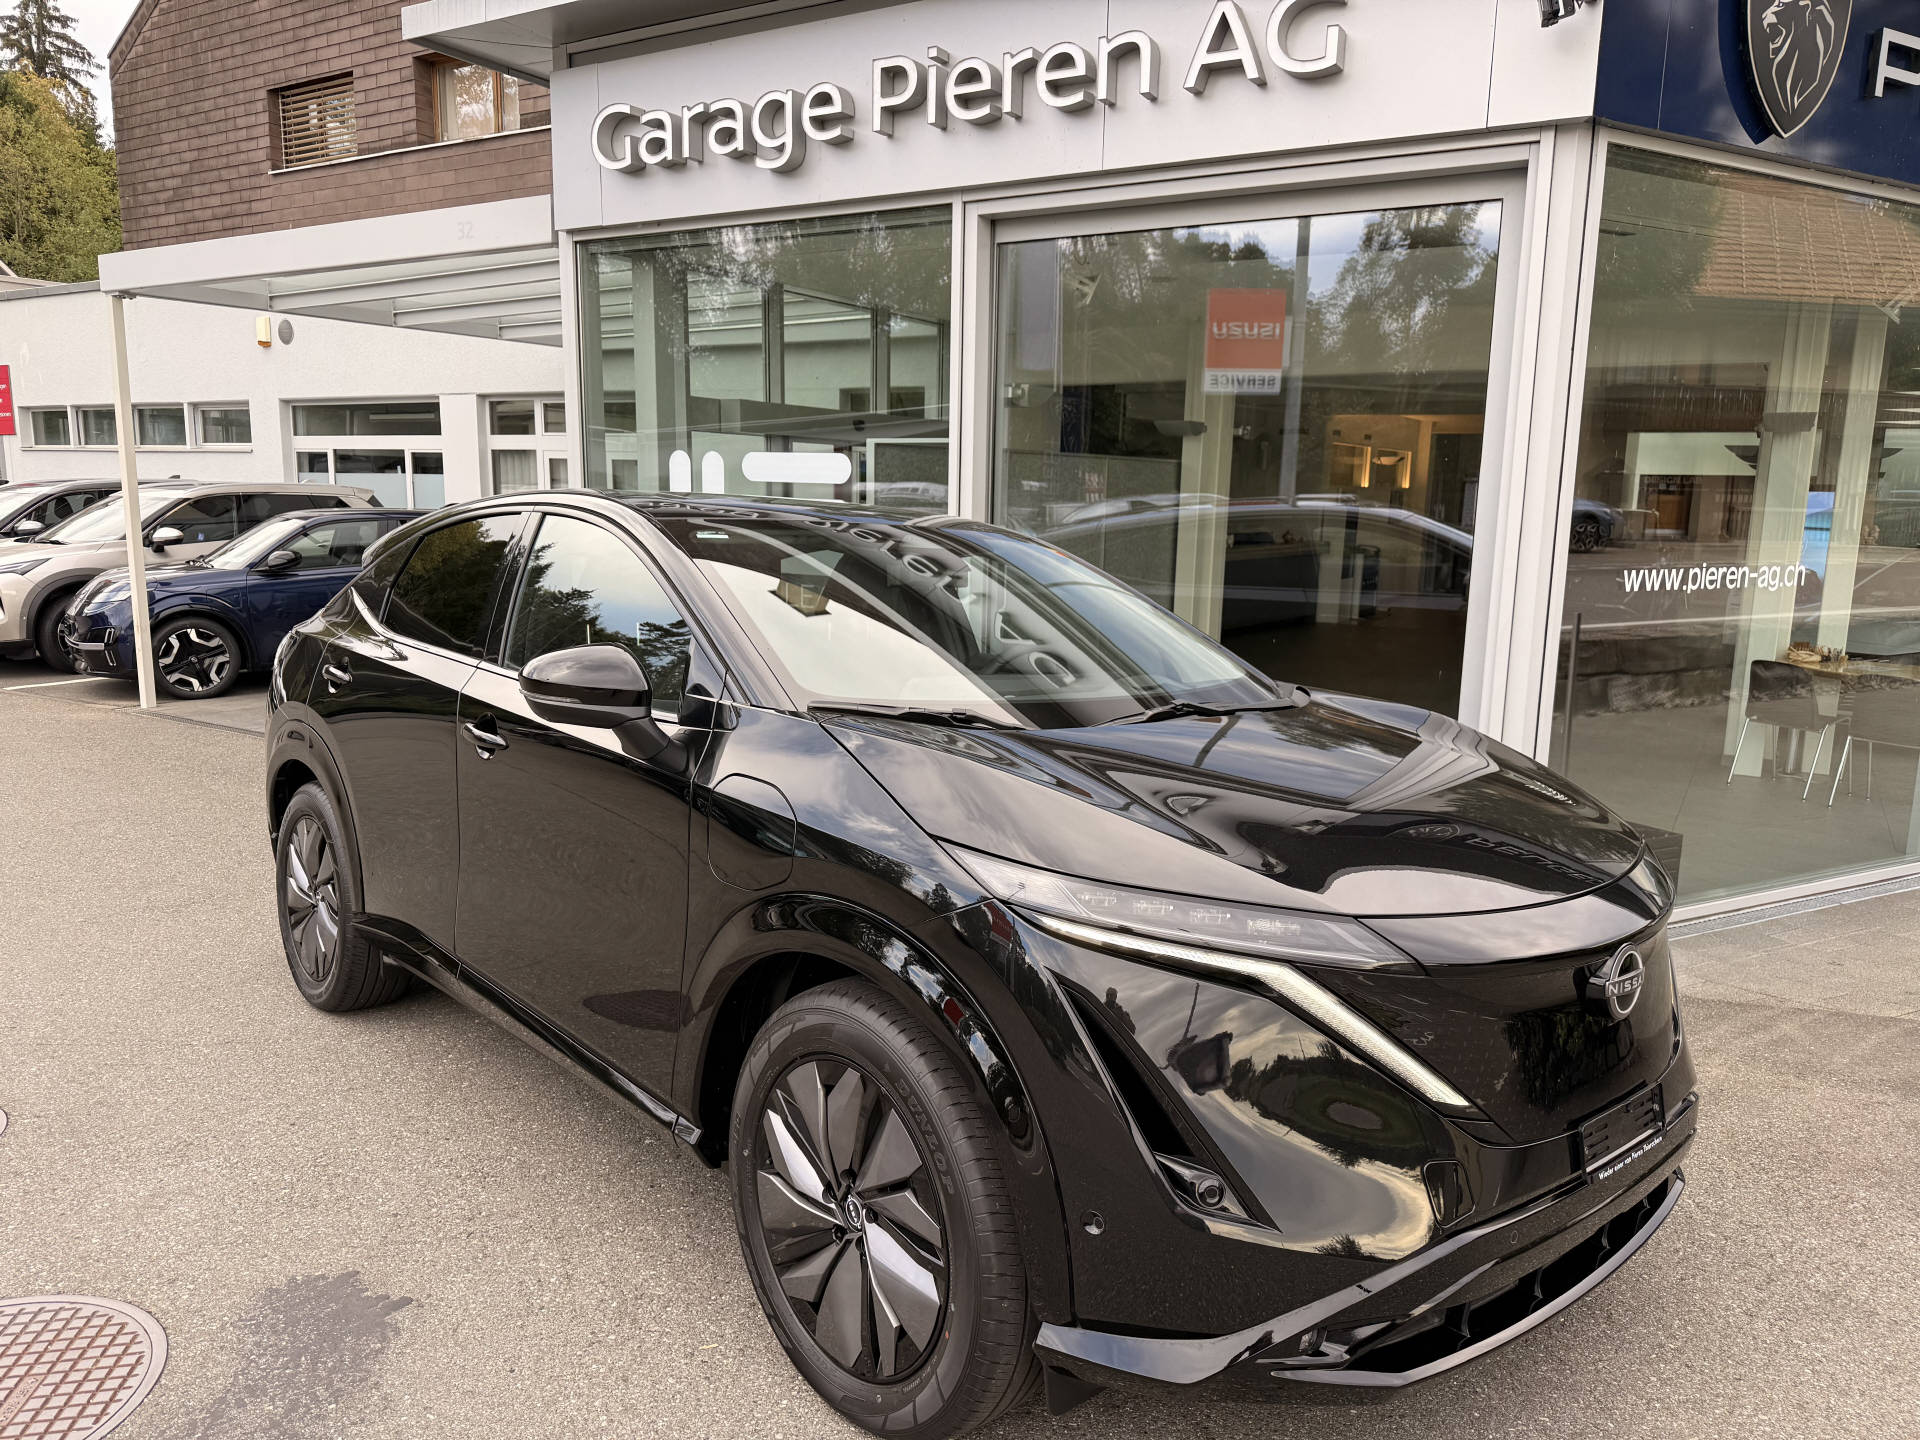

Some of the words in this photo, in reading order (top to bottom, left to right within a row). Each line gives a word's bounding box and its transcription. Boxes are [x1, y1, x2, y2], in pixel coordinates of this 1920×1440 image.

[590, 82, 856, 173] Garage
[872, 29, 1161, 137] Pieren
[1183, 0, 1348, 95] AG
[457, 221, 475, 240] 32
[1623, 561, 1806, 594] www.pieren-ag.ch
[1608, 975, 1642, 996] NISSA
[895, 1079, 955, 1195] DUNLOP
